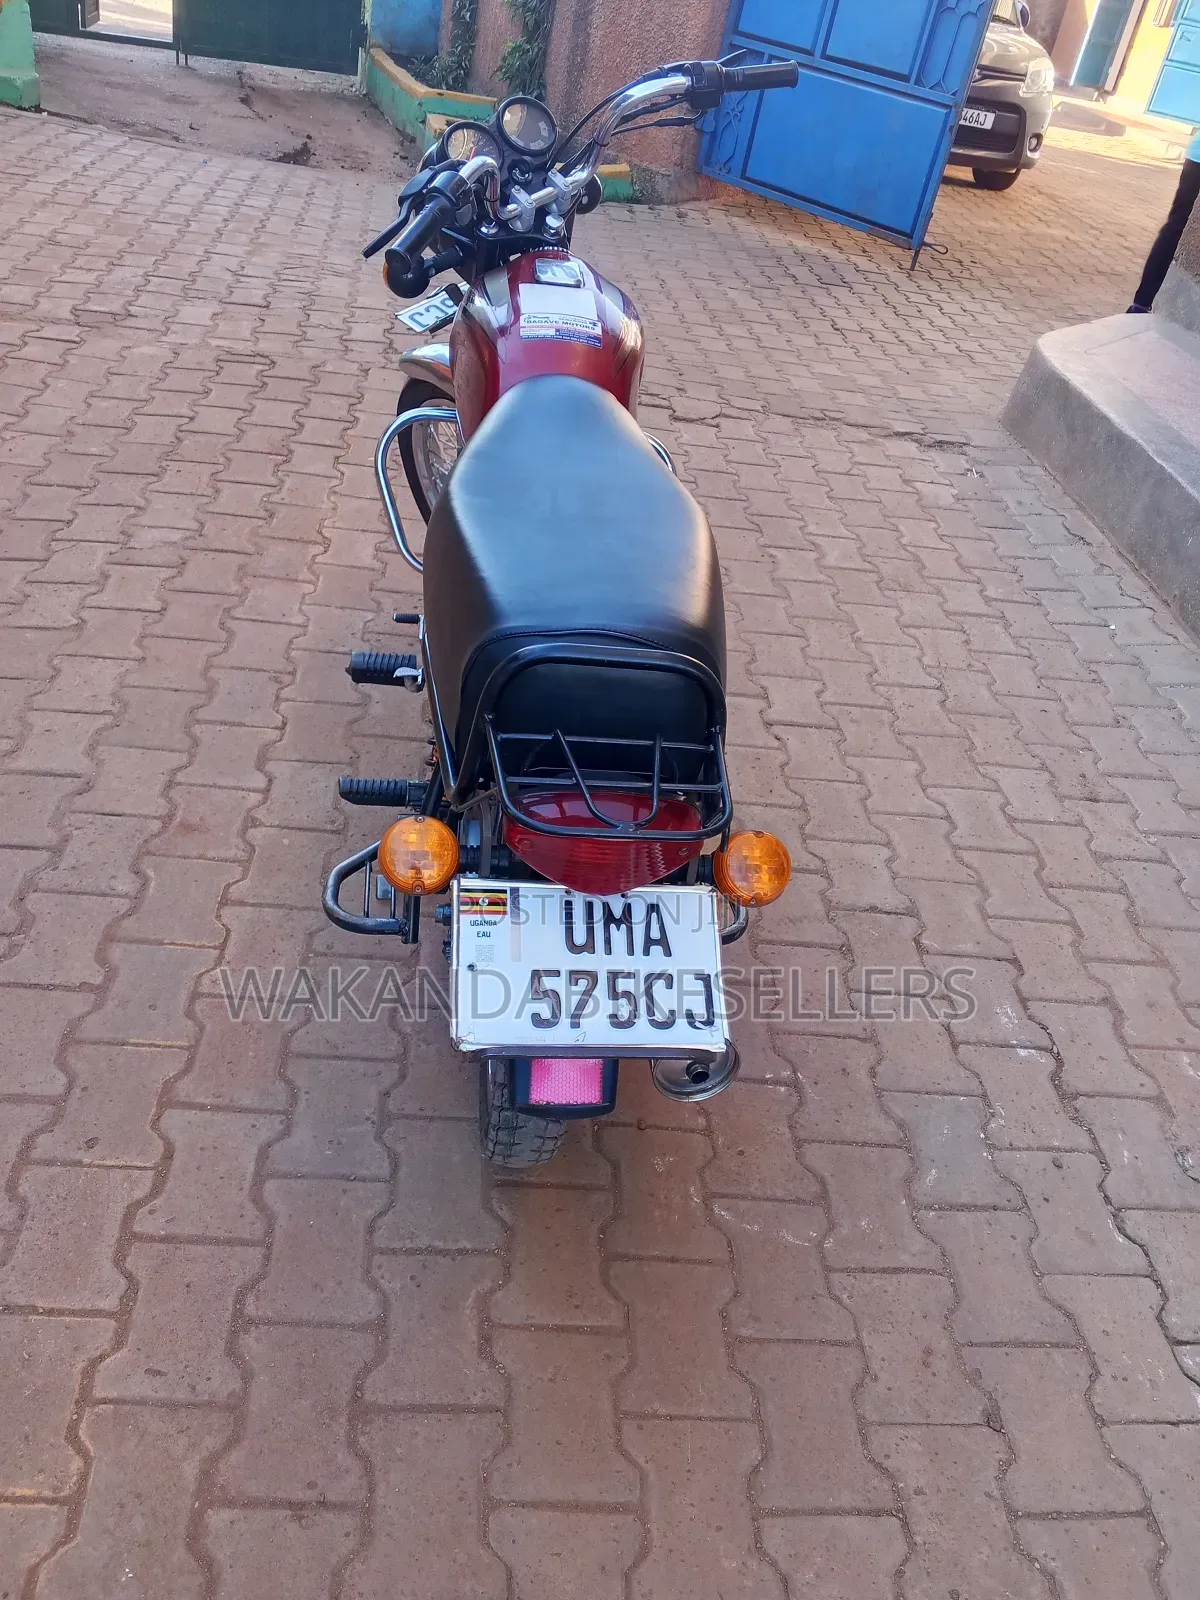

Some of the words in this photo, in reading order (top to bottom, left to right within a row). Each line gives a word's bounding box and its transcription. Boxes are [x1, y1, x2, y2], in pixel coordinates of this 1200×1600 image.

[961, 110, 987, 126] 46AJ
[470, 919, 497, 927] UGANDA
[564, 900, 672, 957] UMA
[530, 970, 716, 1029] 575CJ
